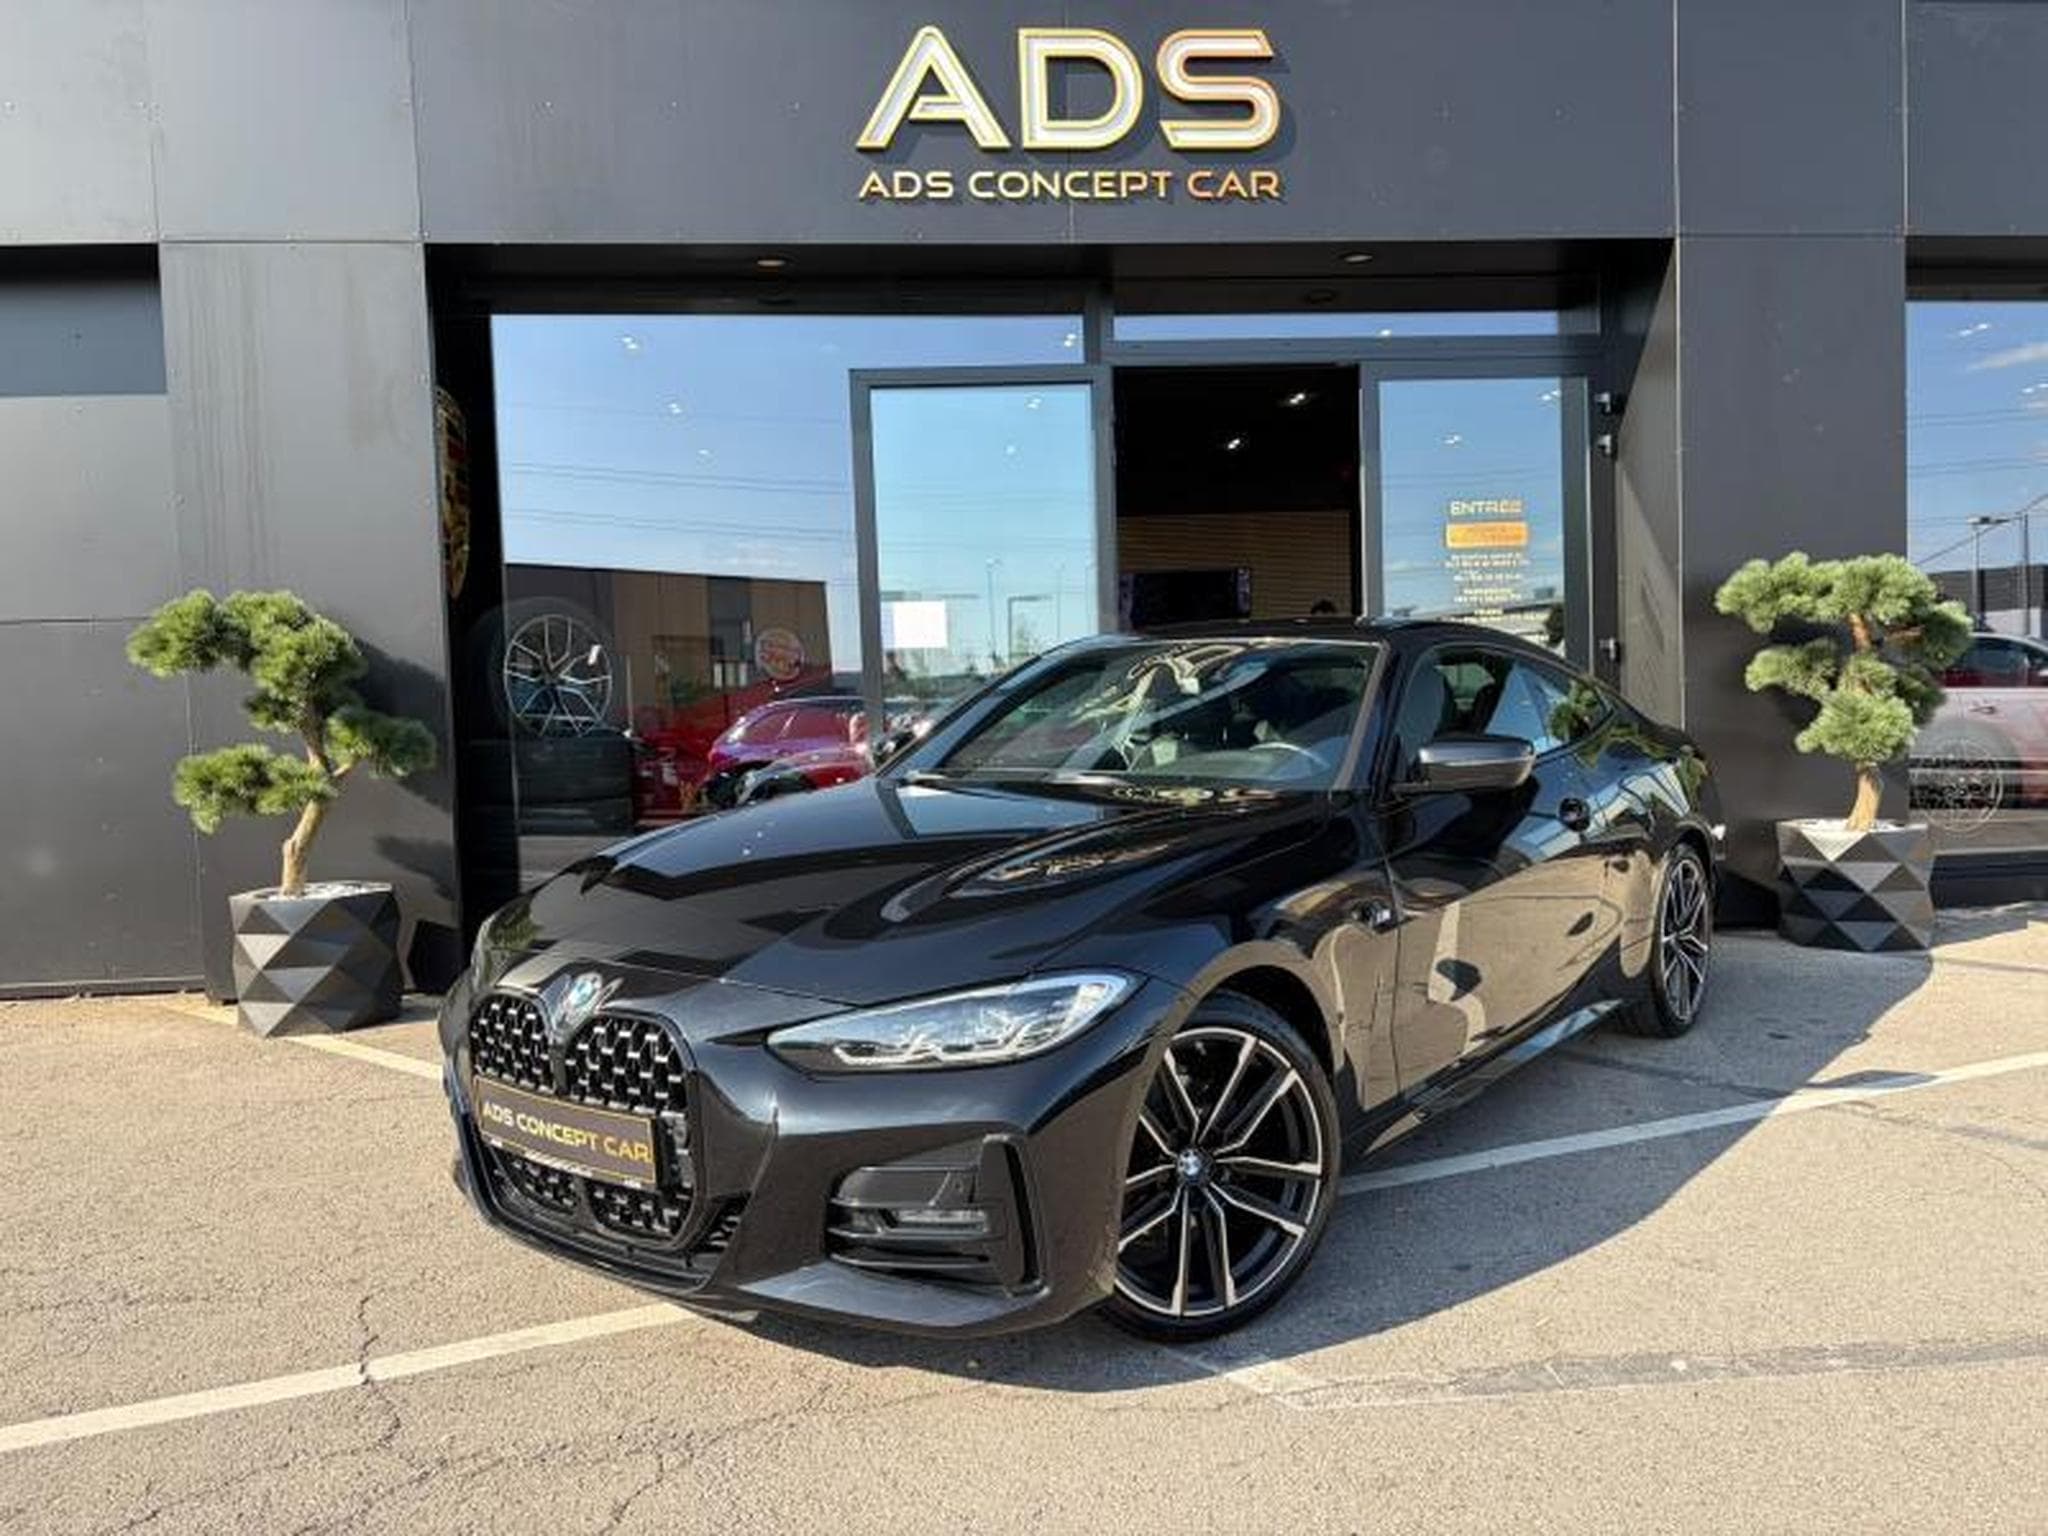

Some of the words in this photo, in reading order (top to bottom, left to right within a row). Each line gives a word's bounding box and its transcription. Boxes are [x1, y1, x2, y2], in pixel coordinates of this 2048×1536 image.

[855, 25, 1281, 150] ADS
[858, 171, 953, 198] ADS
[968, 171, 1173, 198] CONCEPT
[1187, 171, 1280, 198] CAR
[482, 1101, 514, 1127] ADS
[516, 1113, 598, 1150] CONCEPT
[603, 1136, 653, 1162] CAR
